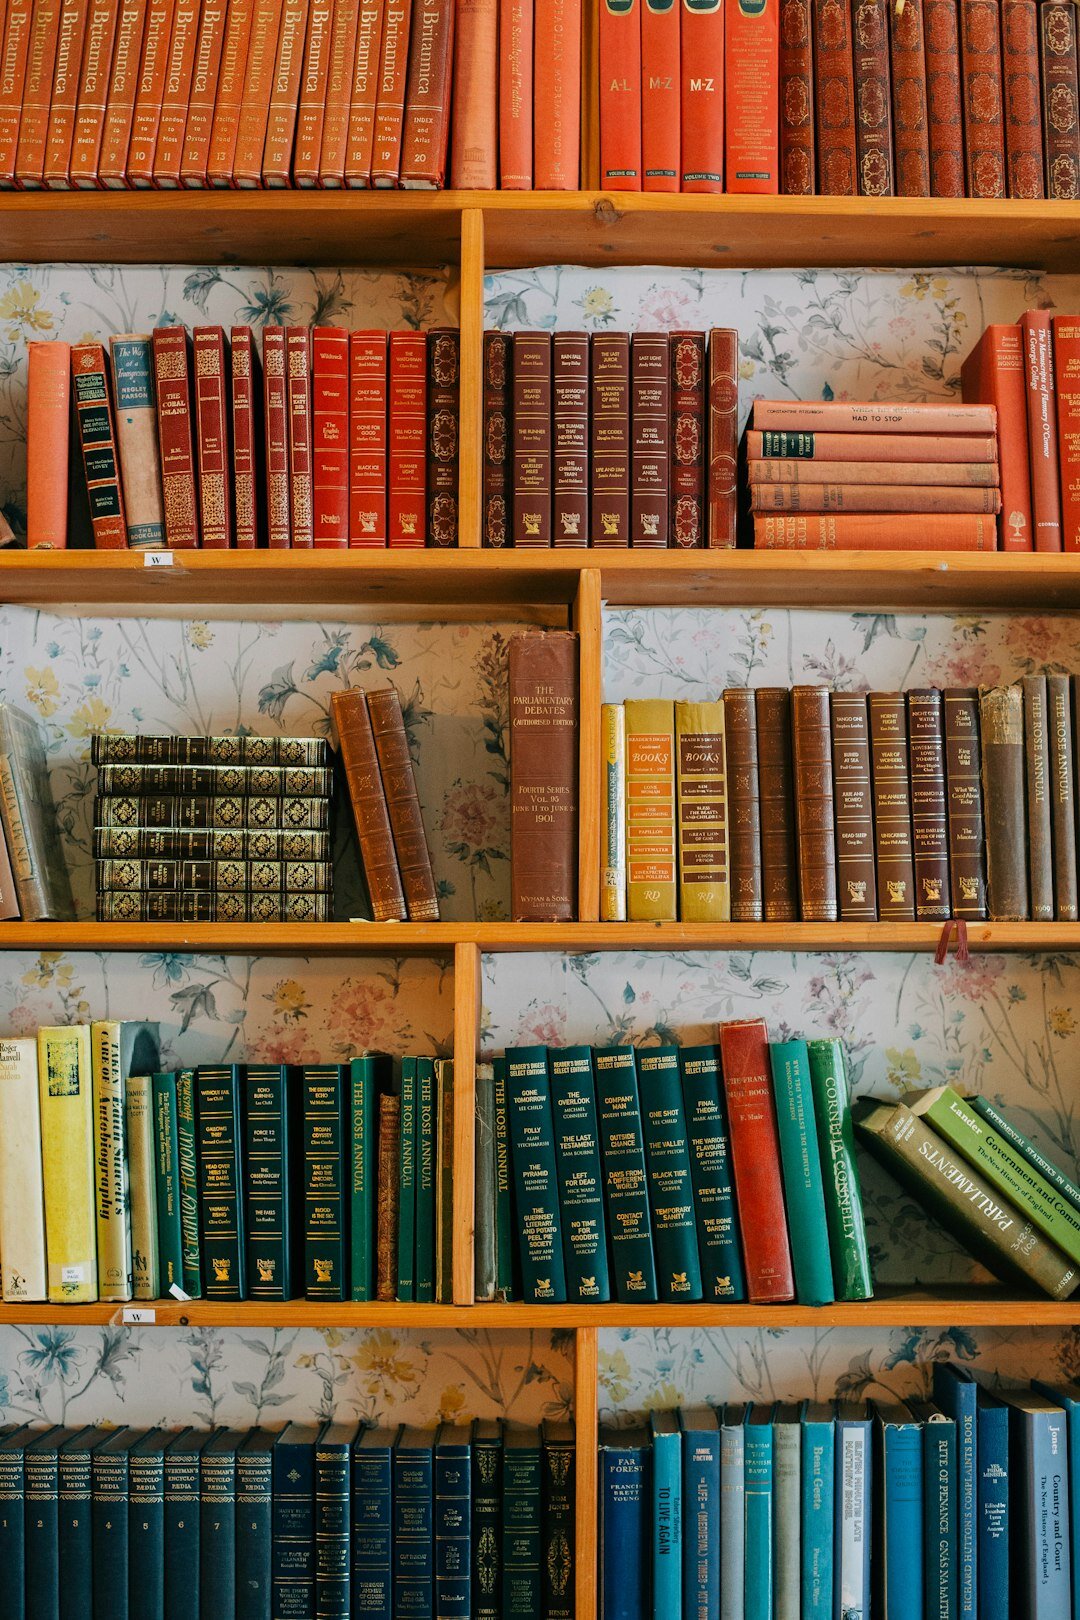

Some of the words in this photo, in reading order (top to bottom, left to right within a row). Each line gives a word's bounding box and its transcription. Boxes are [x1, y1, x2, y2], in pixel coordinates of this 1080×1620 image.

[512, 6, 522, 22] The
[2, 13, 26, 94] Britannica
[56, 12, 78, 94] Britannica
[84, 11, 110, 93] Britannica
[168, 11, 194, 93] Britannica
[195, 10, 221, 93] Britannica
[277, 11, 302, 93] Britannica
[306, 10, 329, 93] Britannica
[383, 10, 404, 93] Britannica
[418, 12, 439, 94] Britannica
[509, 27, 522, 75] Sociological
[512, 75, 522, 118] Tradition
[610, 79, 631, 91] A-L
[649, 77, 673, 89] M-Z
[690, 79, 714, 91] M-Z
[136, 152, 145, 160] 10
[164, 153, 170, 161] 11
[273, 153, 282, 161] 15
[382, 152, 390, 160] 19
[415, 154, 426, 162] 20
[119, 348, 131, 357] The
[132, 348, 145, 358] Way
[1029, 338, 1037, 364] Georgia
[1030, 366, 1039, 390] College
[1040, 384, 1048, 393] of
[161, 408, 187, 416] ISLAND
[513, 697, 575, 705] PARLIAMENTARY
[535, 686, 554, 694] THE
[525, 707, 565, 715] DEBATES
[1032, 694, 1041, 718] THE
[1056, 694, 1064, 718] THE
[1033, 722, 1042, 751] ROSE
[1057, 721, 1067, 750] ROSE
[633, 753, 668, 764] BOOKS
[685, 752, 720, 763] BOOKS
[1034, 754, 1044, 803] ANNUAL
[1058, 754, 1068, 803] ANNUAL
[644, 891, 660, 902] RD
[0, 1043, 17, 1053] Roger
[101, 1031, 109, 1063] CARE
[102, 1067, 109, 1084] OF
[403, 1077, 412, 1100] THE
[421, 1077, 430, 1101] THE
[785, 1061, 794, 1096] O'CONNOR
[354, 1081, 363, 1105] THE
[496, 1080, 504, 1104] THE
[558, 1098, 590, 1106] OVERLOOK
[403, 1105, 412, 1135] ROSE
[421, 1106, 431, 1136] ROSE
[496, 1109, 506, 1138] ROSE
[789, 1098, 797, 1120] JOSEPH
[796, 1095, 805, 1129] ESTRELLA
[950, 1102, 983, 1135] Lander
[354, 1110, 363, 1140] ROSE
[99, 1093, 112, 1220] Autobiography
[825, 1077, 844, 1153] CORNELIA
[836, 1160, 855, 1240] CONNELLY
[986, 1108, 1025, 1147] EXPERIMENTAL
[1026, 1146, 1056, 1176] STATISTICS
[1056, 1176, 1064, 1184] IN
[354, 1144, 364, 1193] ANNUAL
[402, 1139, 412, 1188] ANNUAL
[421, 1139, 431, 1190] ANNUAL
[497, 1142, 508, 1192] ANNUAL
[802, 1148, 810, 1177] CRIMEN
[986, 1136, 1037, 1188] Government
[1036, 1187, 1055, 1204] and
[805, 1178, 811, 1188] EL
[918, 1141, 1014, 1232] PARLIAMENTS
[978, 1146, 988, 1158] The
[988, 1157, 1000, 1172] New
[1000, 1169, 1021, 1192] History
[1021, 1189, 1029, 1198] of
[1028, 1195, 1052, 1219] England
[655, 1206, 691, 1215] TEMPORARY
[571, 1233, 599, 1241] GOODBYE
[964, 1415, 973, 1444] BOOK
[1049, 1425, 1060, 1455] Jones
[814, 1446, 824, 1475] Beau
[939, 1440, 948, 1467] RITE
[939, 1469, 948, 1483] OF
[964, 1446, 973, 1510] COMPLAINTS
[659, 1487, 670, 1499] TO
[814, 1478, 824, 1510] Geste
[1052, 1475, 1061, 1517] Country
[659, 1502, 670, 1521] LIVE
[939, 1485, 948, 1534] PENANCE
[143, 1522, 148, 1530] 5
[659, 1525, 670, 1555] AGAIN
[964, 1512, 972, 1561] HUTTON'S
[1054, 1520, 1062, 1539] and
[1054, 1542, 1063, 1571] Court
[964, 1563, 972, 1611] RICHARD
